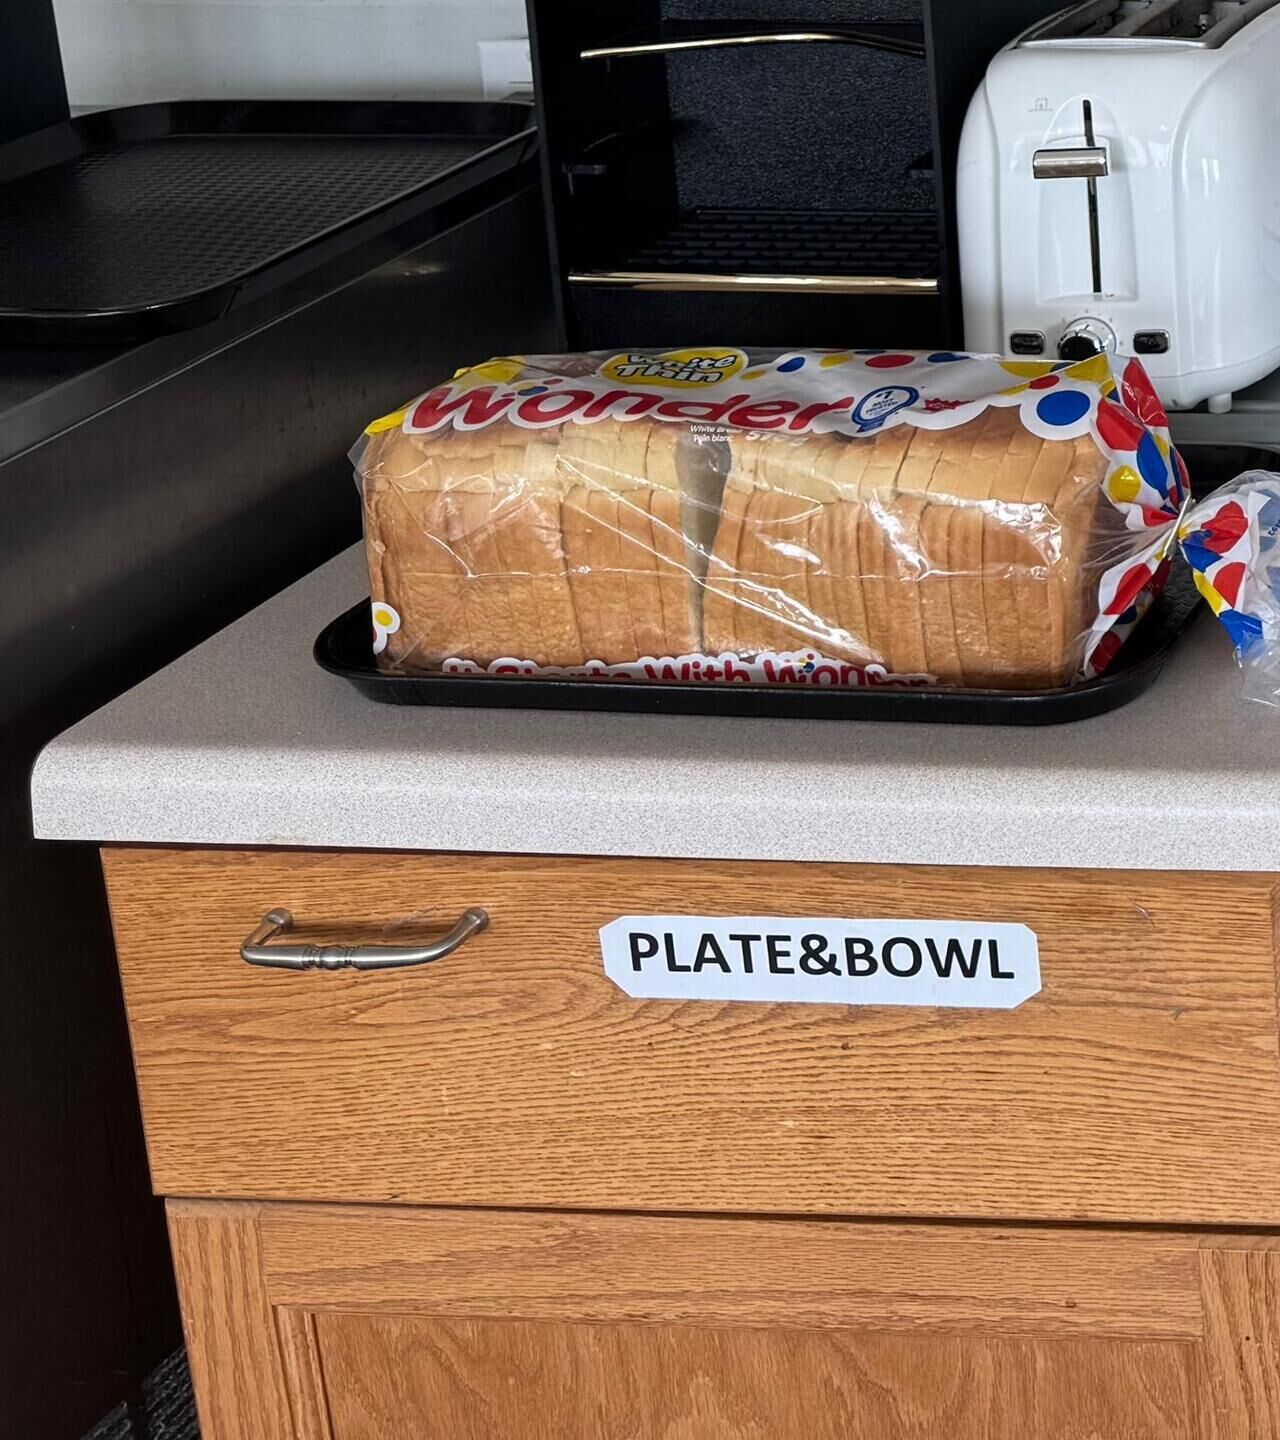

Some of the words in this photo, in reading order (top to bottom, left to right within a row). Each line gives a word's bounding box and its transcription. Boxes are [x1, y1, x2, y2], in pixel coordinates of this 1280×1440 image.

[615, 363, 723, 383] Thin
[408, 387, 855, 430] Wonder
[690, 424, 716, 433] White
[628, 931, 1016, 979] PLATE&BOWL
